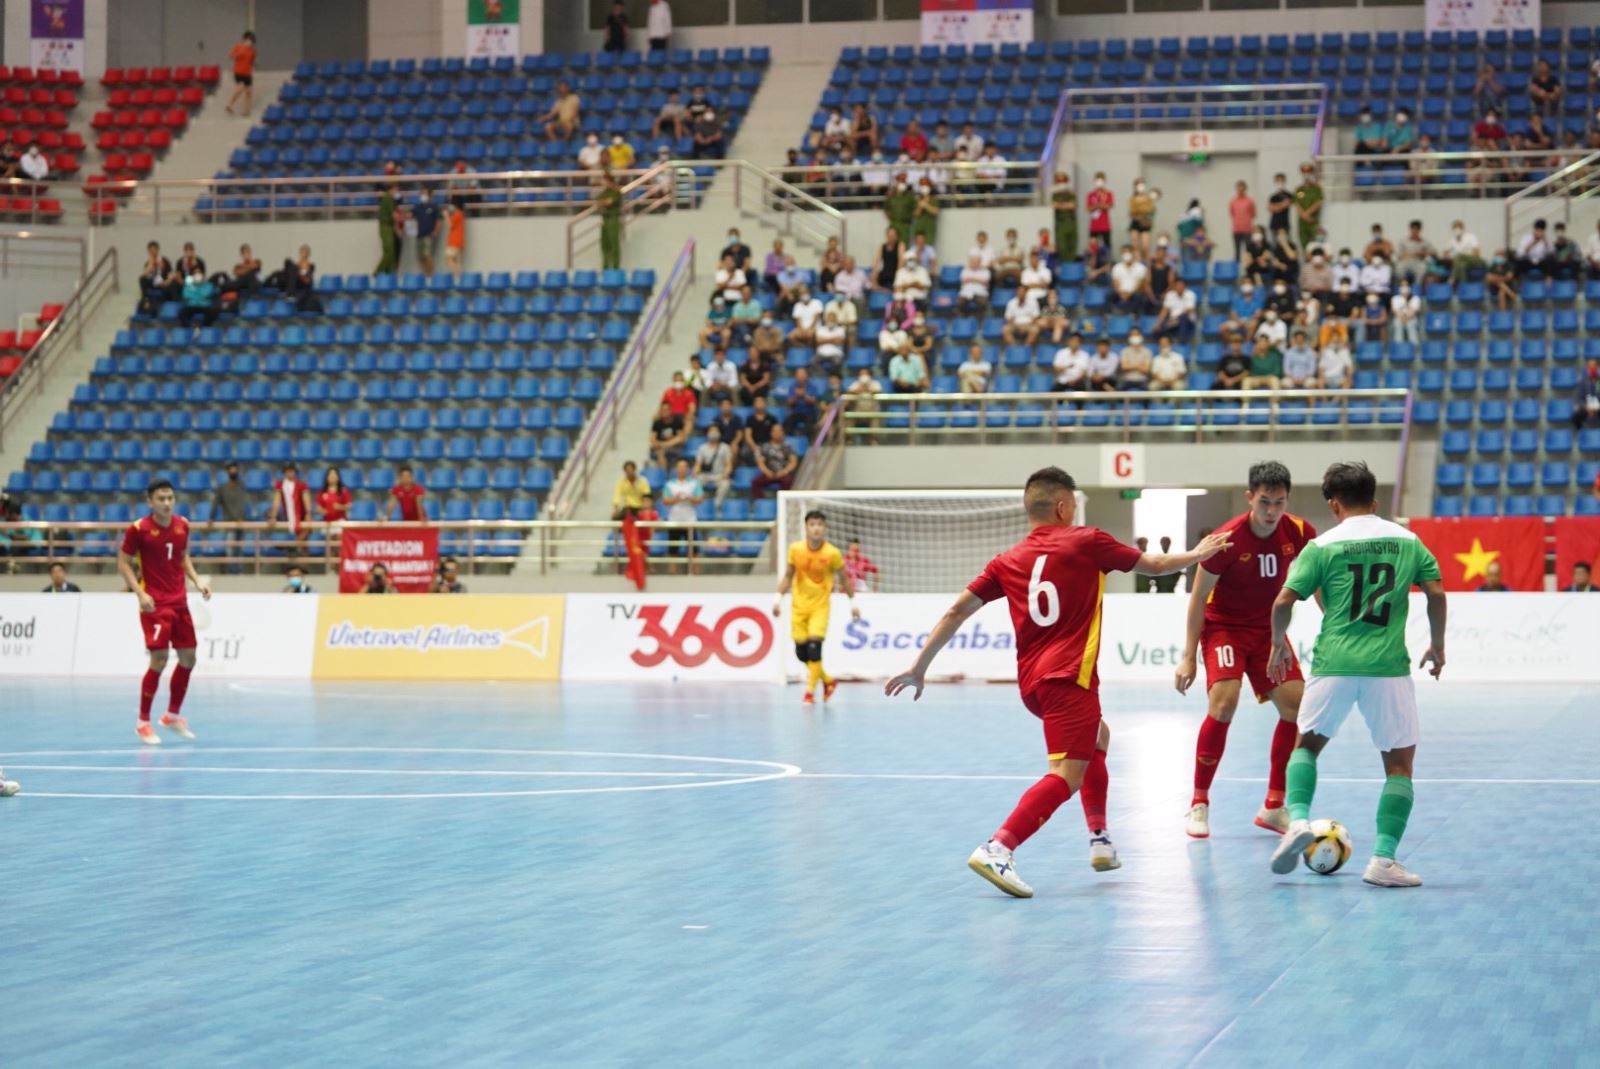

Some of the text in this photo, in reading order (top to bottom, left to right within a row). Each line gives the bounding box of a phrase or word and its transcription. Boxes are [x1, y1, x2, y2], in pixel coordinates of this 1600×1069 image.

[1115, 452, 1133, 477] C
[165, 542, 174, 560] 7
[1343, 541, 1400, 556] ARDIANSYAH
[1257, 553, 1278, 578] 10
[1028, 554, 1060, 627] 6
[1347, 562, 1396, 627] 12
[153, 624, 162, 641] 7
[328, 622, 502, 650] Vietravel Airlines
[1214, 645, 1235, 669] 10
